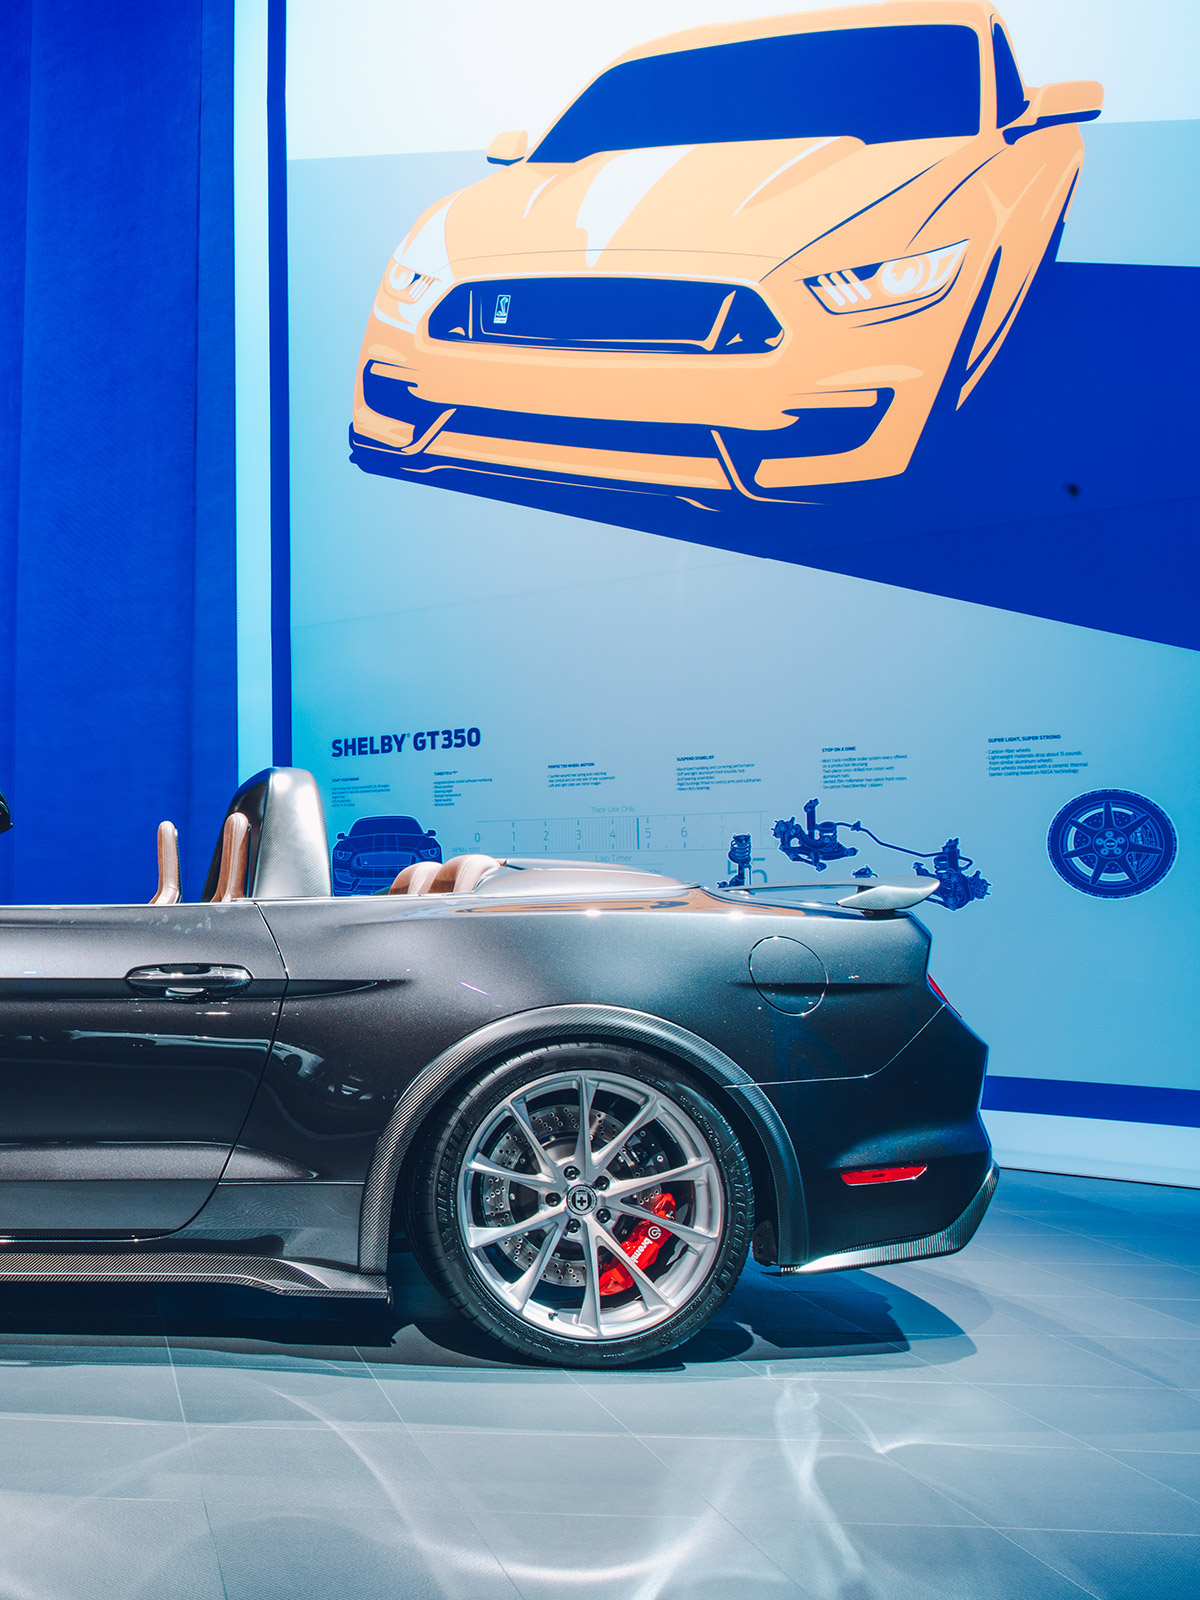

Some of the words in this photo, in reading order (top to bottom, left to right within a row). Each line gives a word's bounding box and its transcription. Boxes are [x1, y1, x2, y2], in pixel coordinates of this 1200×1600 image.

[331, 733, 407, 757] SHELBY
[413, 727, 481, 751] GT350
[512, 831, 516, 842] 1
[543, 830, 549, 841] 2
[576, 829, 582, 840] 3
[609, 829, 616, 838] 4
[645, 827, 652, 839] 5
[681, 826, 688, 838] 6
[595, 855, 609, 863] Lap
[437, 1120, 467, 1221] MICHELIN
[720, 1182, 746, 1282] MICHELIN
